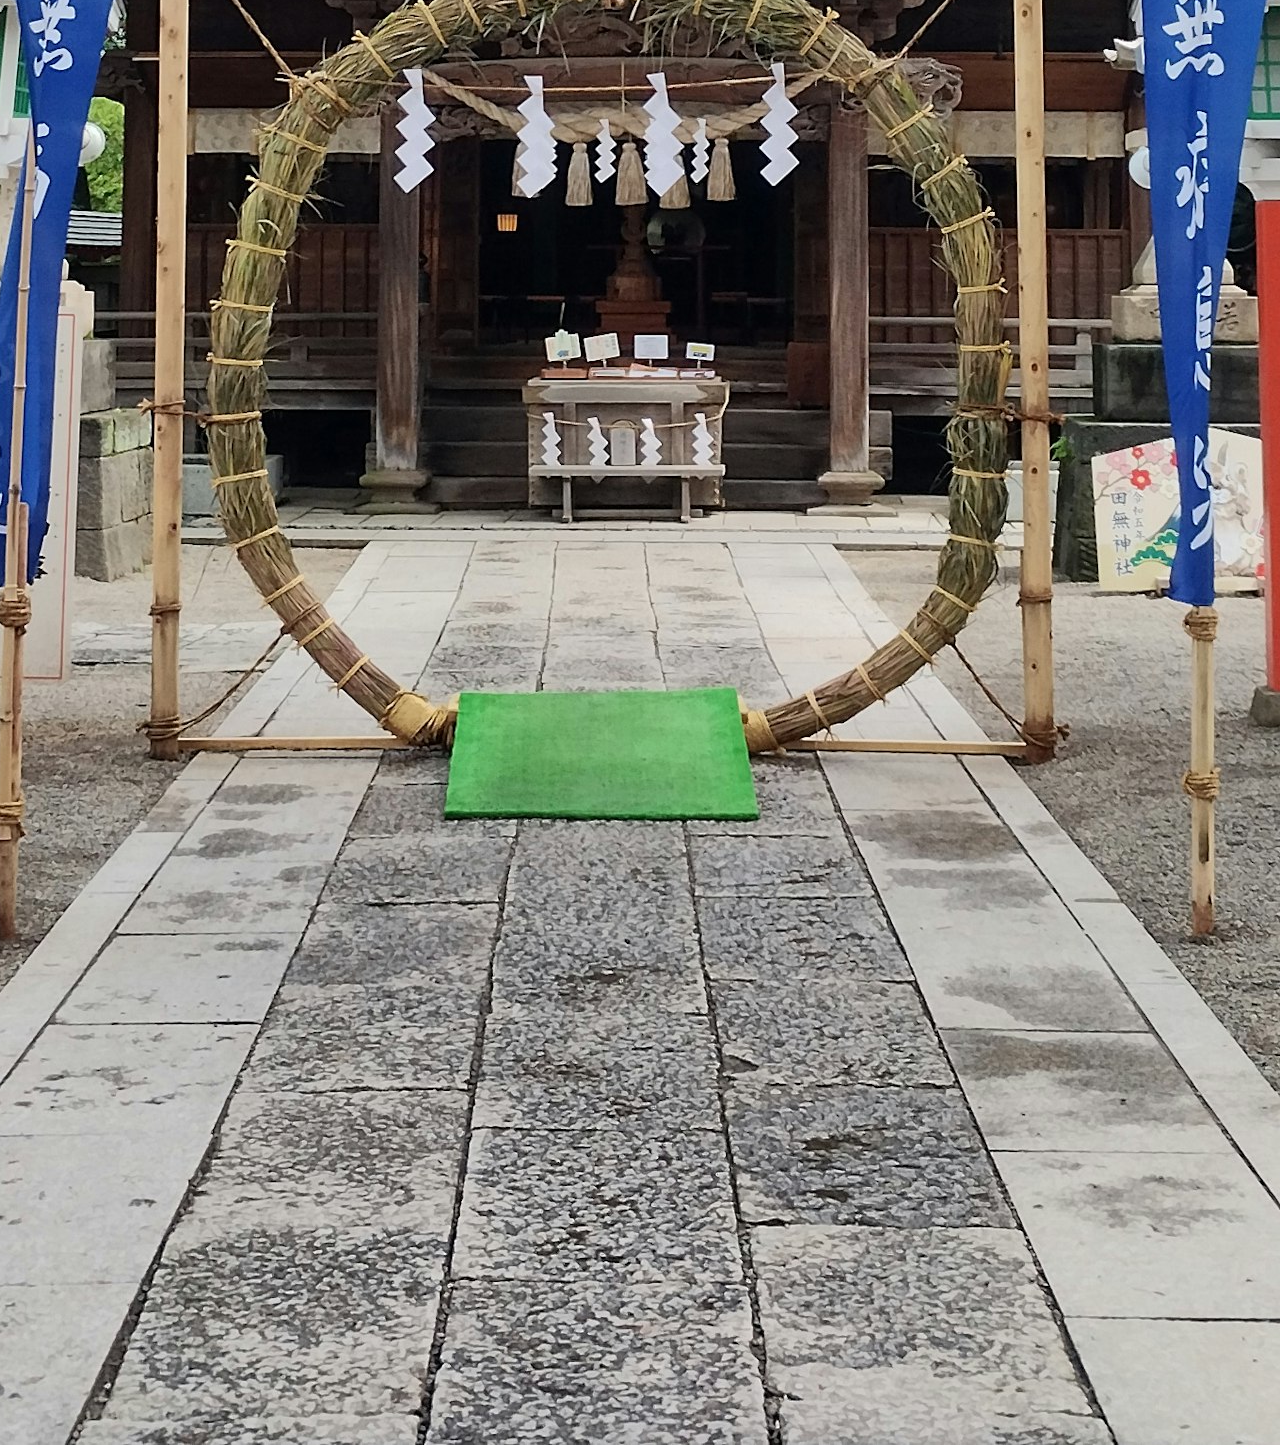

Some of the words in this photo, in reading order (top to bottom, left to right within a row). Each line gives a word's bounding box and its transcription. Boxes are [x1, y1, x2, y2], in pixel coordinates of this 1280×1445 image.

[1110, 491, 1134, 577] 田無神社
[1132, 491, 1145, 540] 令和五年
